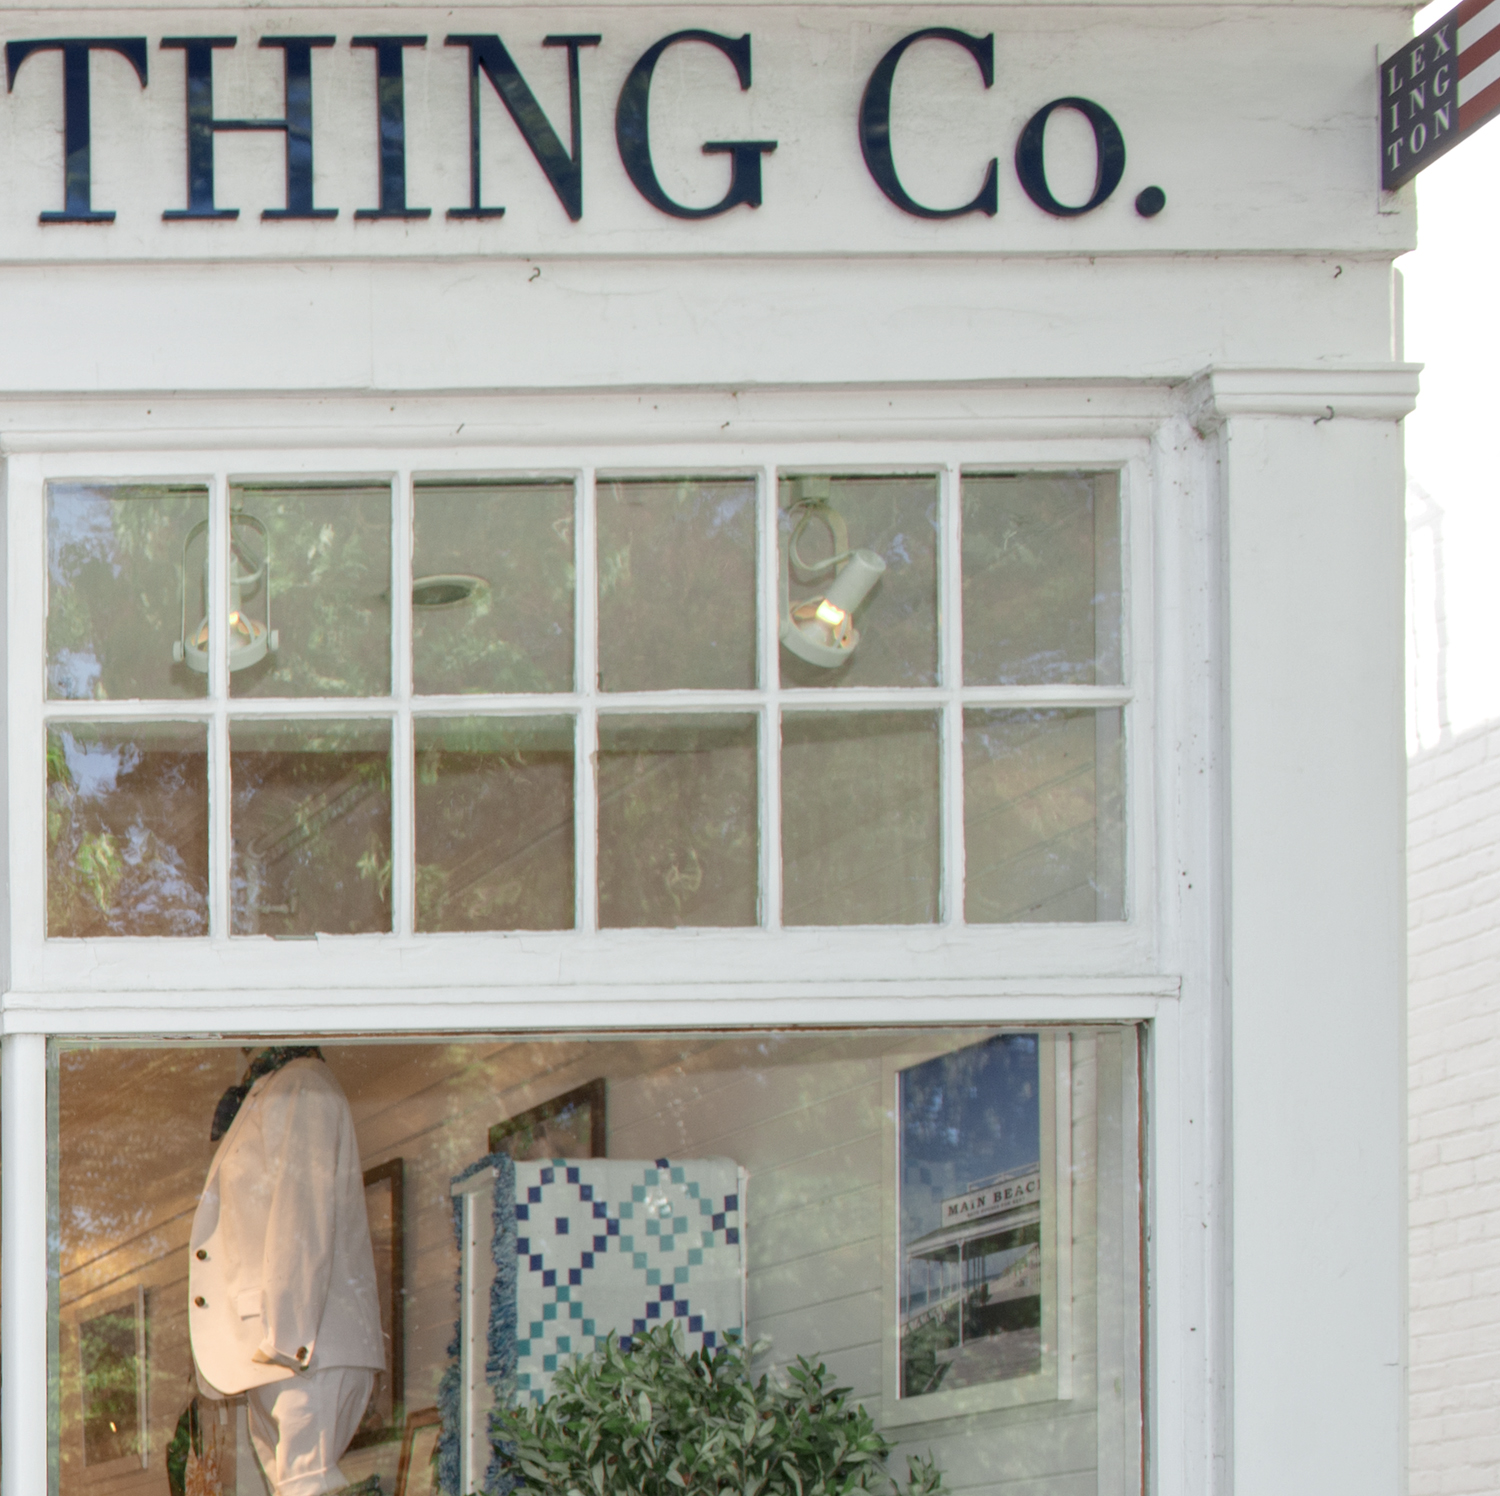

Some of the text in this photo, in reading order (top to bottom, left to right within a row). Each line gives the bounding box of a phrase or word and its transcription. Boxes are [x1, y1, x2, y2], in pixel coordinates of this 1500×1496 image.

[1388, 24, 1450, 97] LEX
[858, 25, 1167, 218] Co.
[1390, 64, 1450, 133] ING
[1388, 101, 1451, 172] TON
[948, 1196, 986, 1216] MAIN
